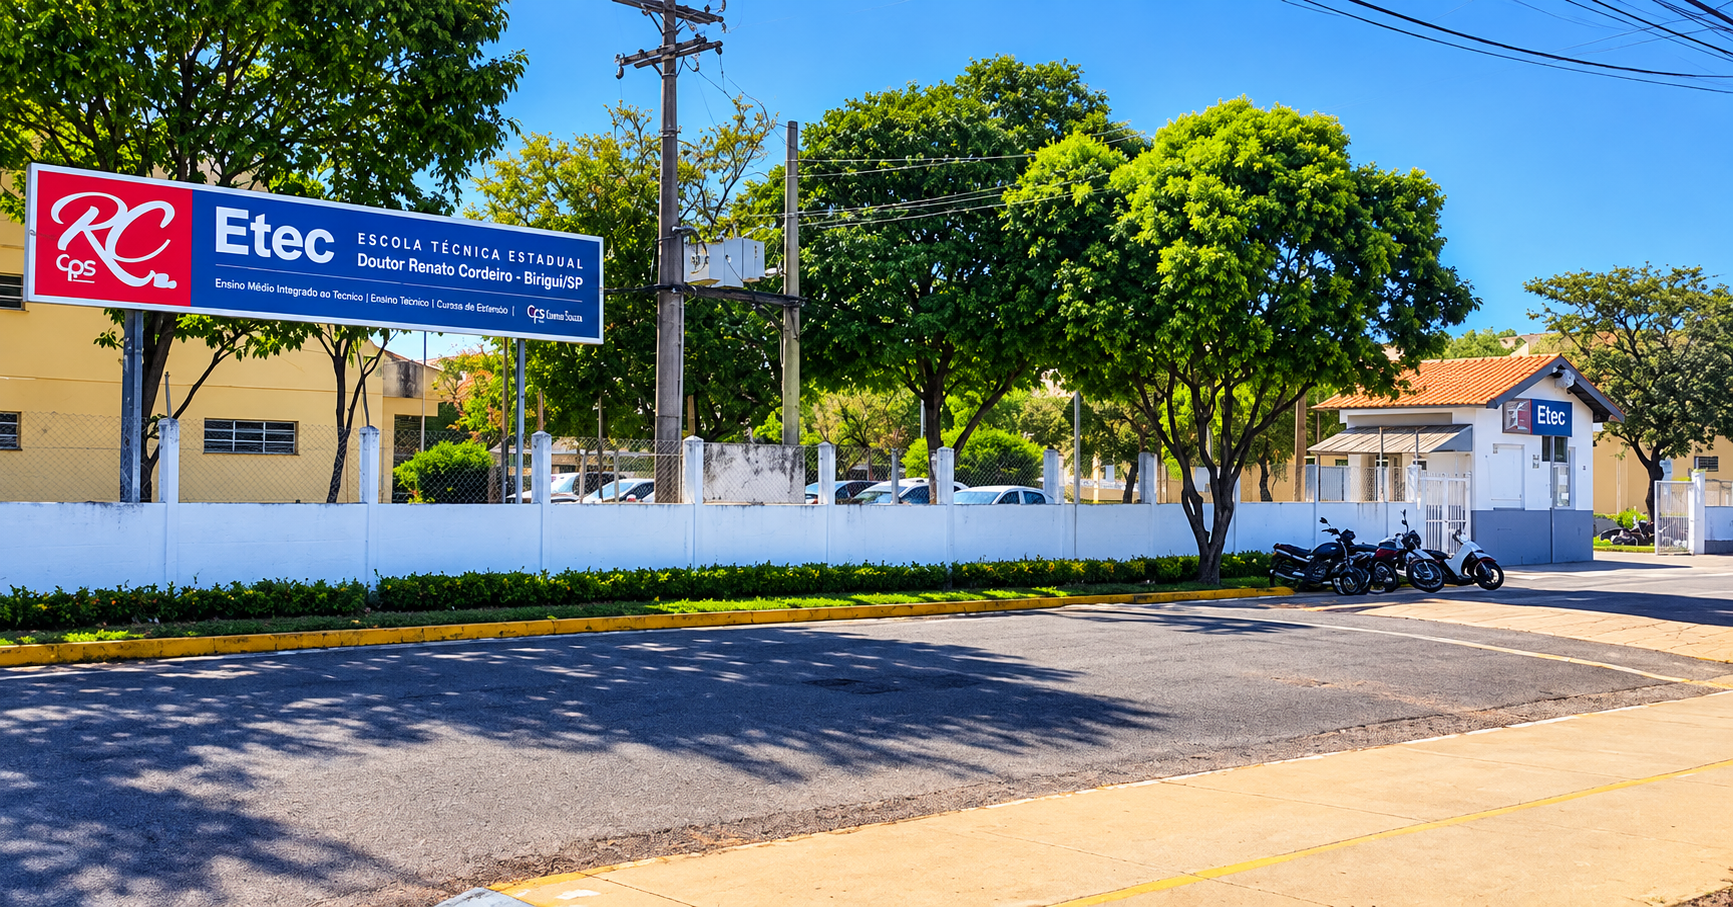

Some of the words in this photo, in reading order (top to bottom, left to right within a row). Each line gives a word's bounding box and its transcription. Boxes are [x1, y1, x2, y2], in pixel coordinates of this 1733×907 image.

[215, 206, 335, 264] Etec
[358, 232, 422, 251] ESCOLA
[430, 240, 500, 261] TÉCNICA
[508, 250, 583, 270] ESTADUAL
[215, 278, 246, 290] Ensino
[247, 281, 275, 293] Médio
[276, 284, 318, 298] Integrado
[358, 253, 406, 271] Doutor
[408, 257, 455, 276] Renato
[458, 263, 513, 283] Cordeiro
[524, 271, 583, 291] Birigui/SP
[1537, 405, 1566, 425] Etec
